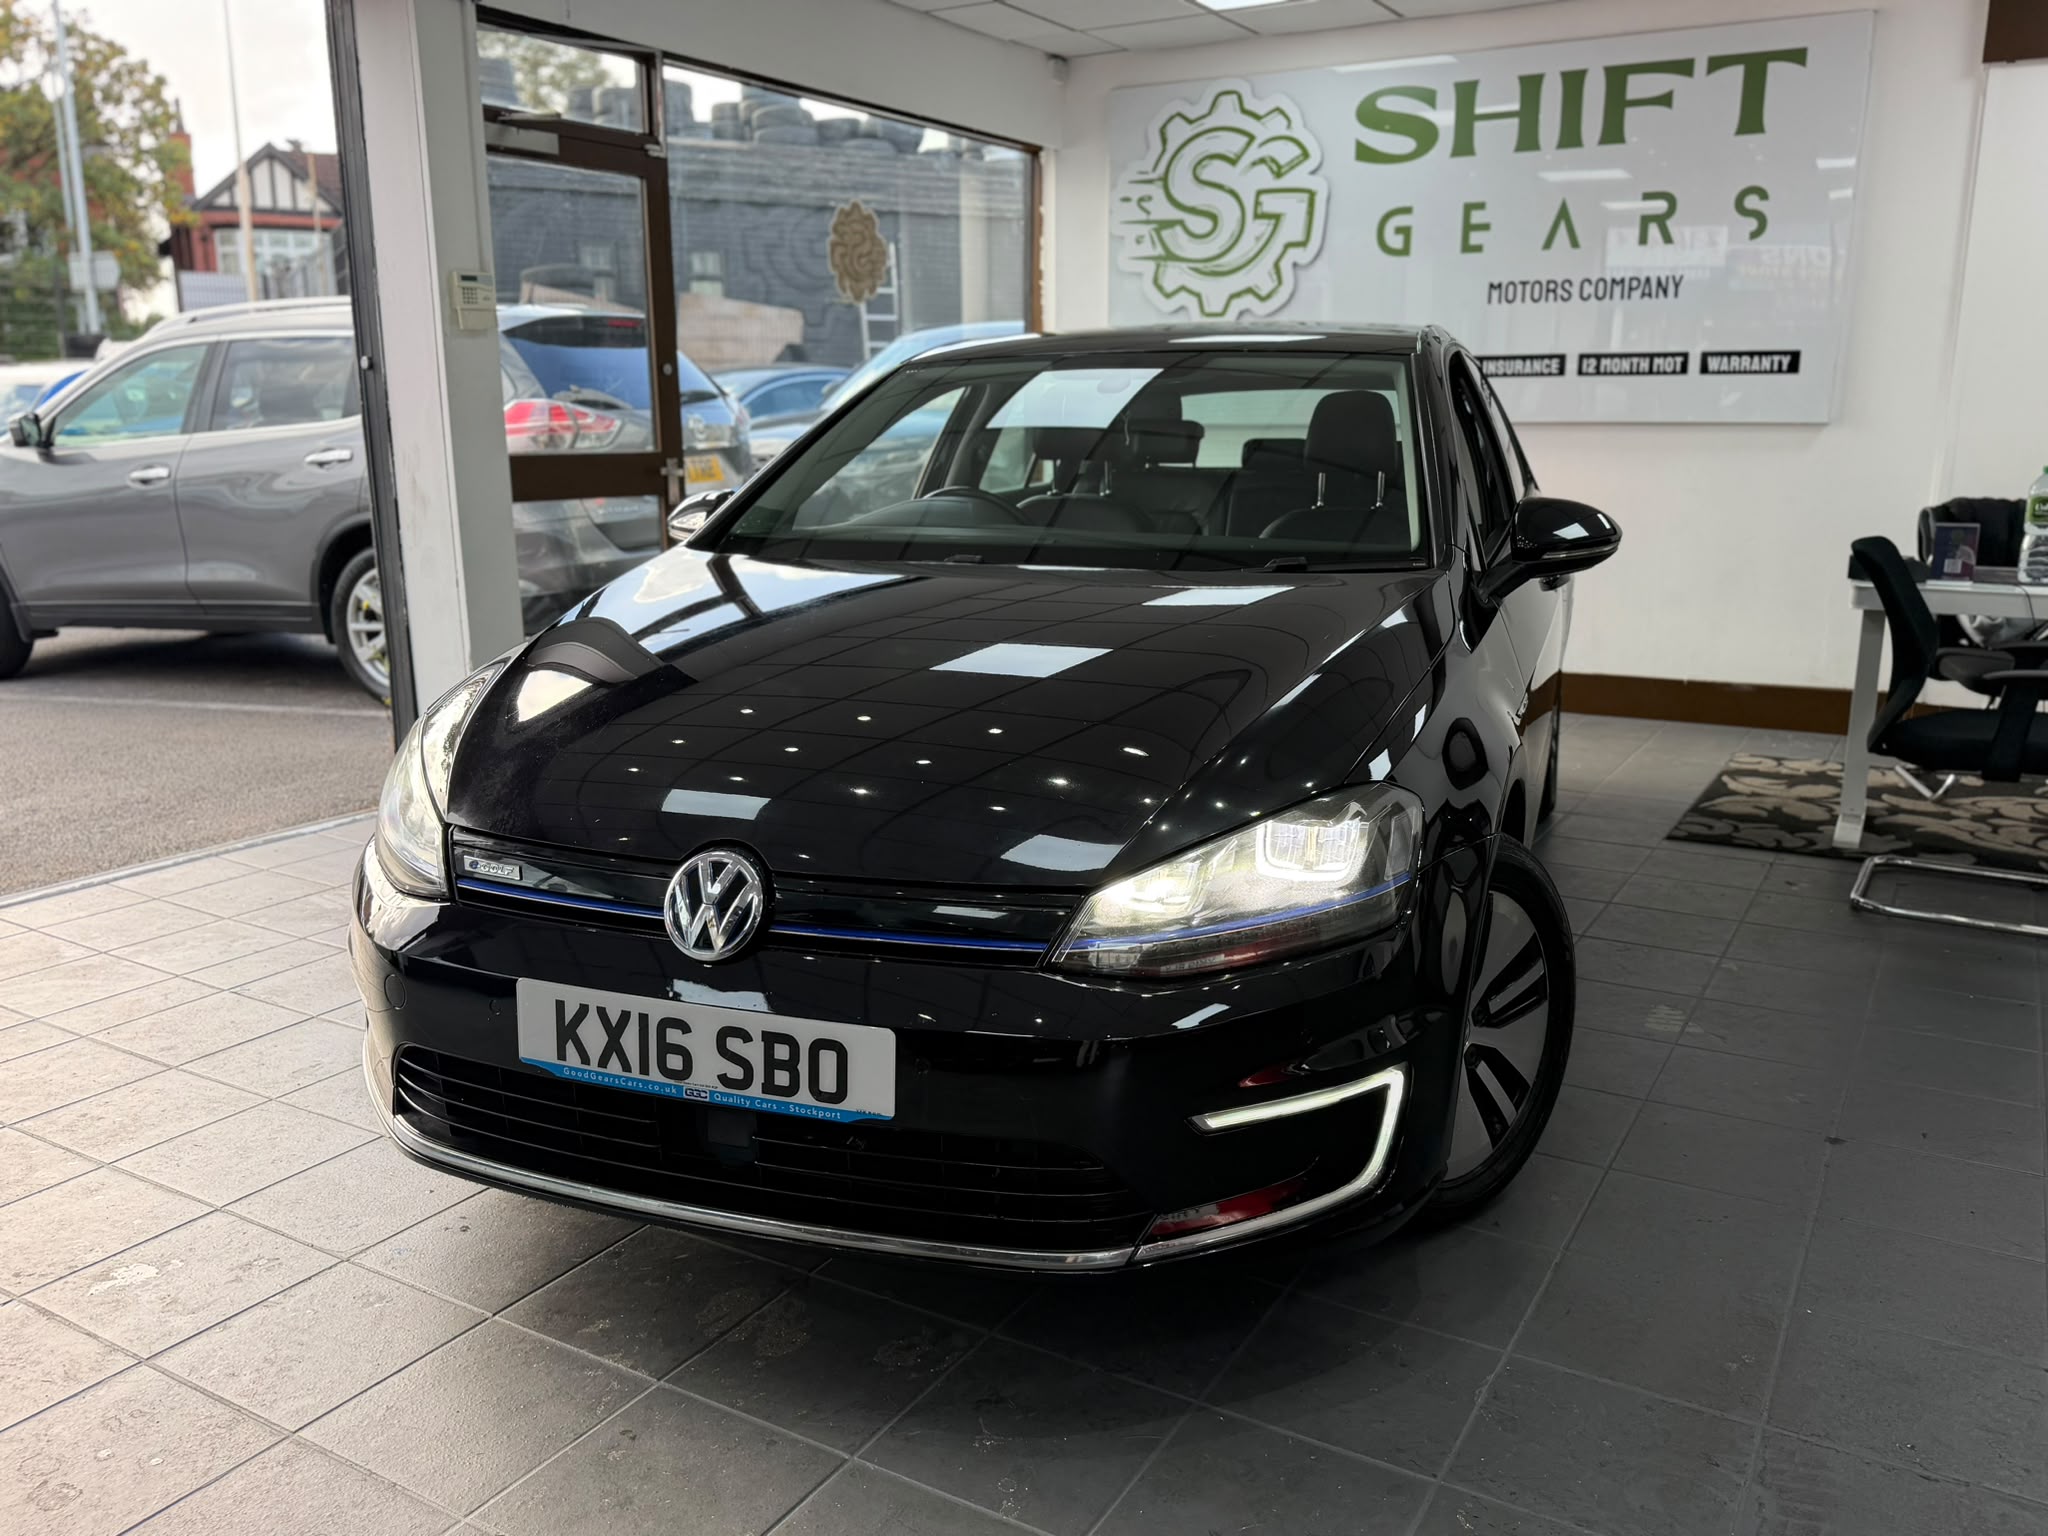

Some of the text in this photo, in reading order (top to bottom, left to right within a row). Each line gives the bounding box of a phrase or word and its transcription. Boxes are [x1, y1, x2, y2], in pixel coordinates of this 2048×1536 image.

[1354, 47, 1808, 165] SHIFT
[1376, 185, 1770, 257] GEARS
[1487, 278, 1573, 305] MOTORS
[1579, 274, 1685, 302] COMPANY
[1482, 358, 1560, 376] INSURANCE
[1582, 355, 1685, 374] 12 MONTH MOT
[1706, 354, 1792, 372] WARRANTY
[555, 999, 848, 1105] KX16 SBO
[563, 1066, 678, 1095] GoodGearsCars.co.uk
[713, 1092, 751, 1108] Quality
[755, 1099, 778, 1111] Cars
[789, 1104, 841, 1120] Stockport
